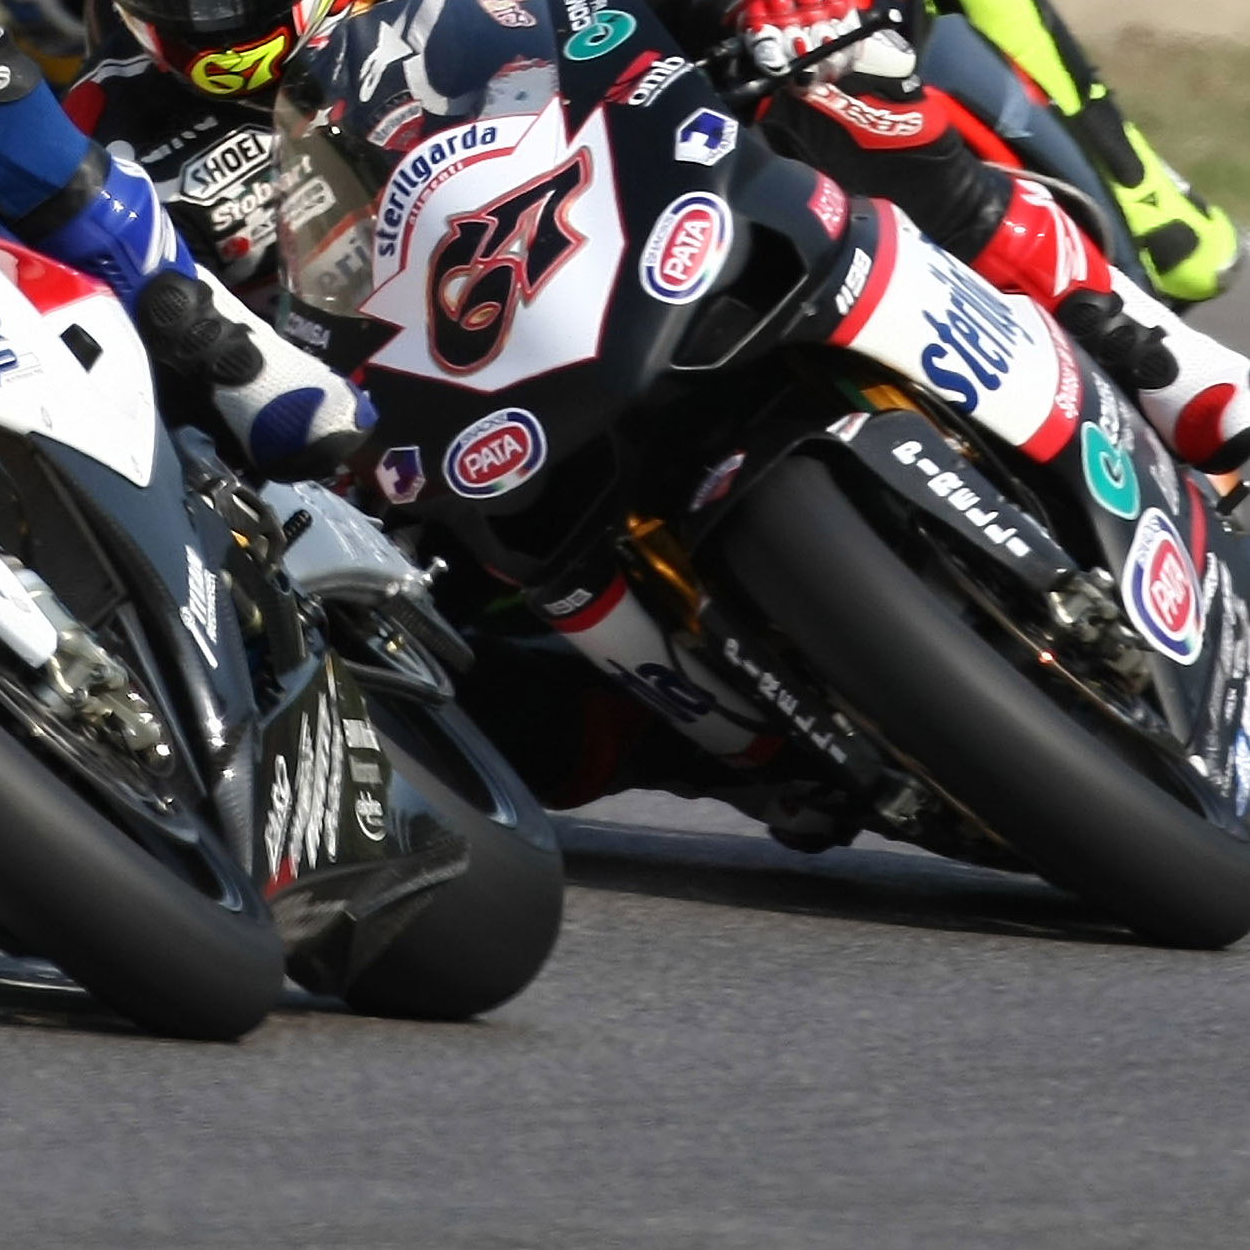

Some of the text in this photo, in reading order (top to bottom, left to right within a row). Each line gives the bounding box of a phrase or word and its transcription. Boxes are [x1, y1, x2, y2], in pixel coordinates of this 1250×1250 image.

[191, 33, 286, 94] 67
[191, 132, 267, 194] SHOEI
[376, 124, 498, 257] sterilgarda
[662, 220, 710, 281] PATA
[463, 433, 524, 481] PATA
[891, 440, 1032, 558] PIRELLI
[724, 637, 848, 764] PIRELLI
